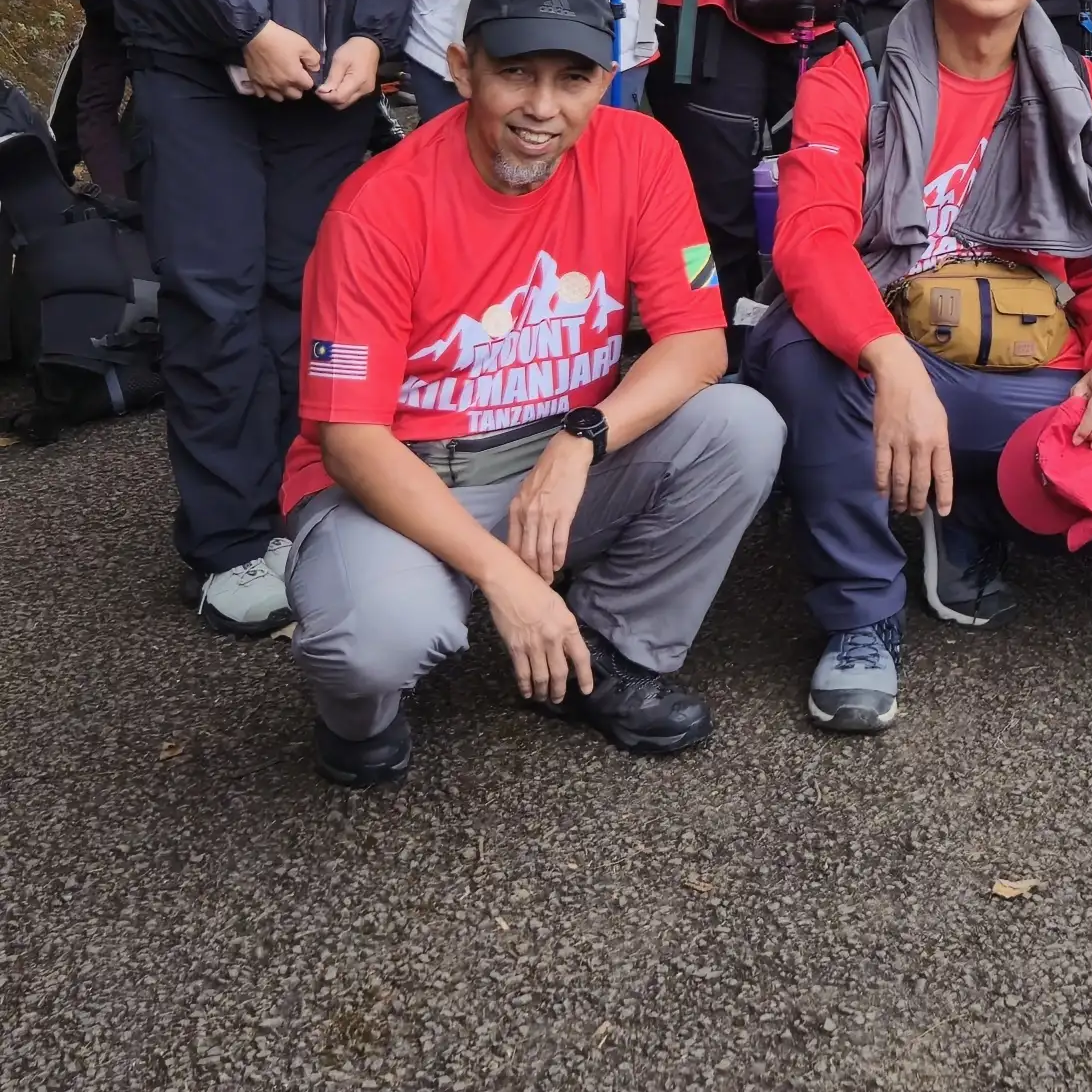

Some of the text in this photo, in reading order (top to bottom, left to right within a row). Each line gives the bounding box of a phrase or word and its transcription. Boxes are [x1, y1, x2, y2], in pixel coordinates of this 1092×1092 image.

[399, 334, 622, 413] KILIMANJARO
[469, 316, 586, 378] MOUNT
[467, 395, 570, 434] TANZANIA
